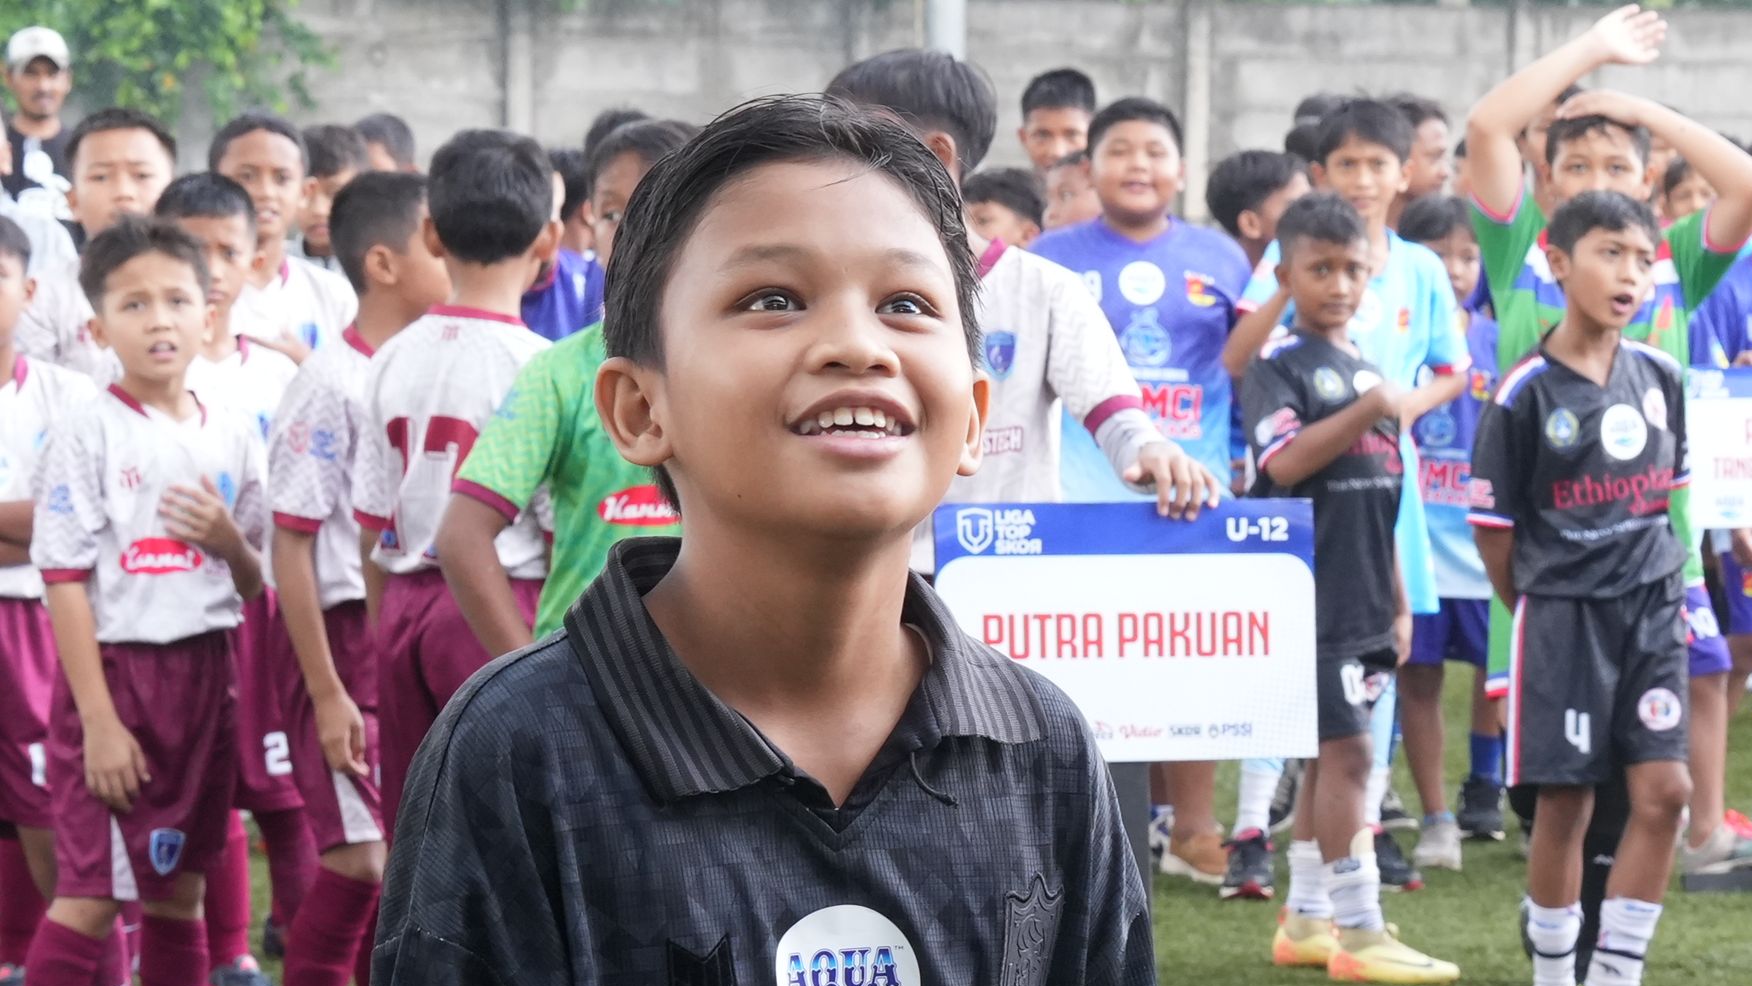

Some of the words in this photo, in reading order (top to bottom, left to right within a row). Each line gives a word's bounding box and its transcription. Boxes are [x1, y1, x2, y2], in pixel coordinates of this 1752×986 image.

[1225, 515, 1290, 543] U-12
[981, 613, 1104, 660] PUTRA
[1117, 610, 1270, 658] PAKUAN
[1564, 707, 1592, 754] 4
